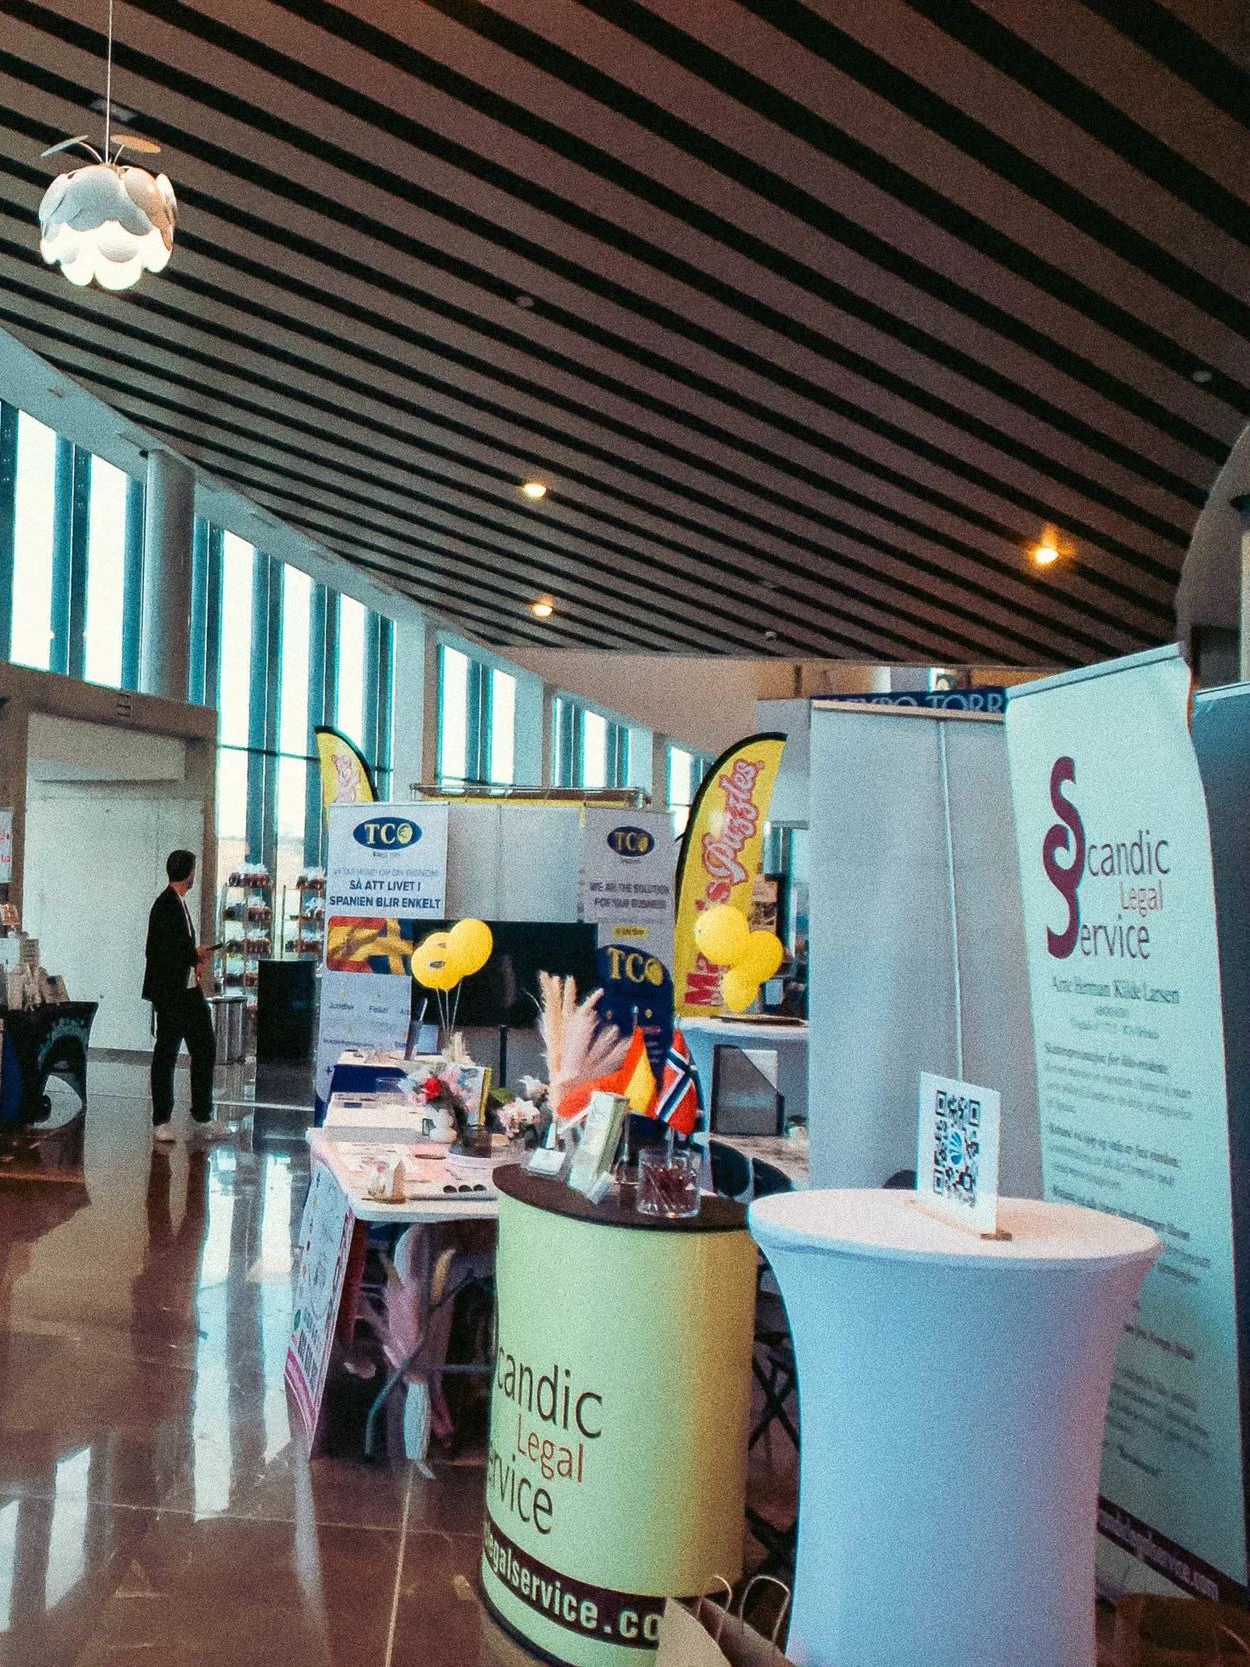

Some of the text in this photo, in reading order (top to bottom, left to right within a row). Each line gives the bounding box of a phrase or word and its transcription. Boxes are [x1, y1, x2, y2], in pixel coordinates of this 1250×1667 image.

[364, 822, 414, 845] TCO
[702, 758, 758, 886] Puzzles
[614, 831, 649, 852] TCO
[349, 878, 363, 891] SÅ
[364, 880, 385, 891] ATT
[387, 881, 416, 892] LIVET
[1118, 879, 1164, 918] Legal
[329, 895, 442, 909] SPANIEN BLIR ENKELT
[606, 946, 664, 987] TCO
[516, 1413, 584, 1483] Legal
